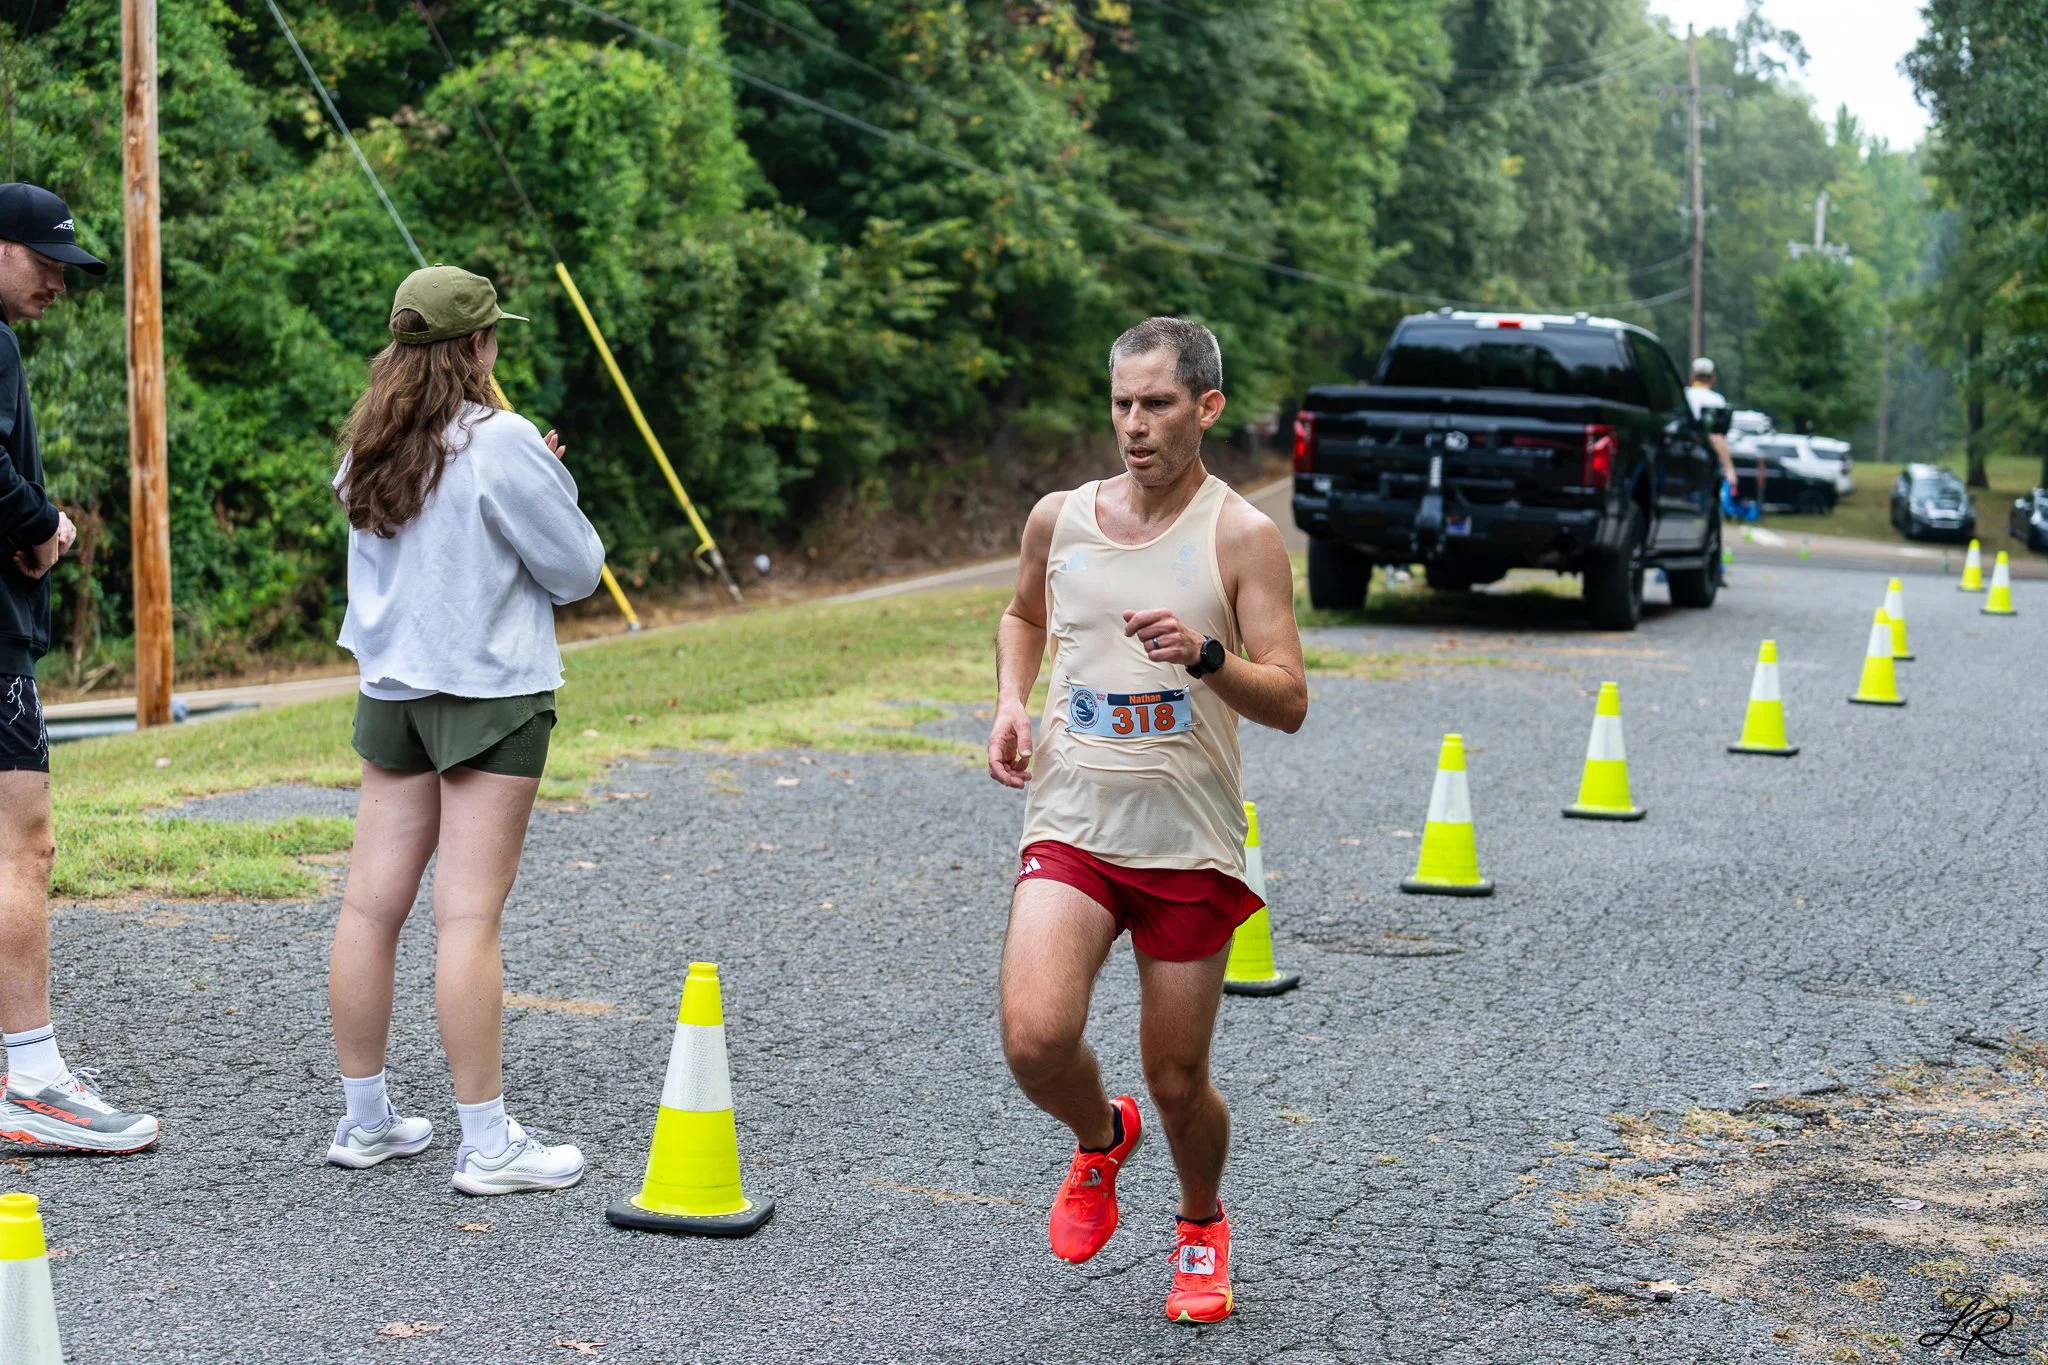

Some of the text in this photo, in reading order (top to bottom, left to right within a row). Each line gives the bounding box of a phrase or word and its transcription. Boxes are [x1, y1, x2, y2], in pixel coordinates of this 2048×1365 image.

[1129, 693, 1162, 705] Nathan
[1112, 703, 1176, 735] 318
[12, 1099, 93, 1127] ALTRA
